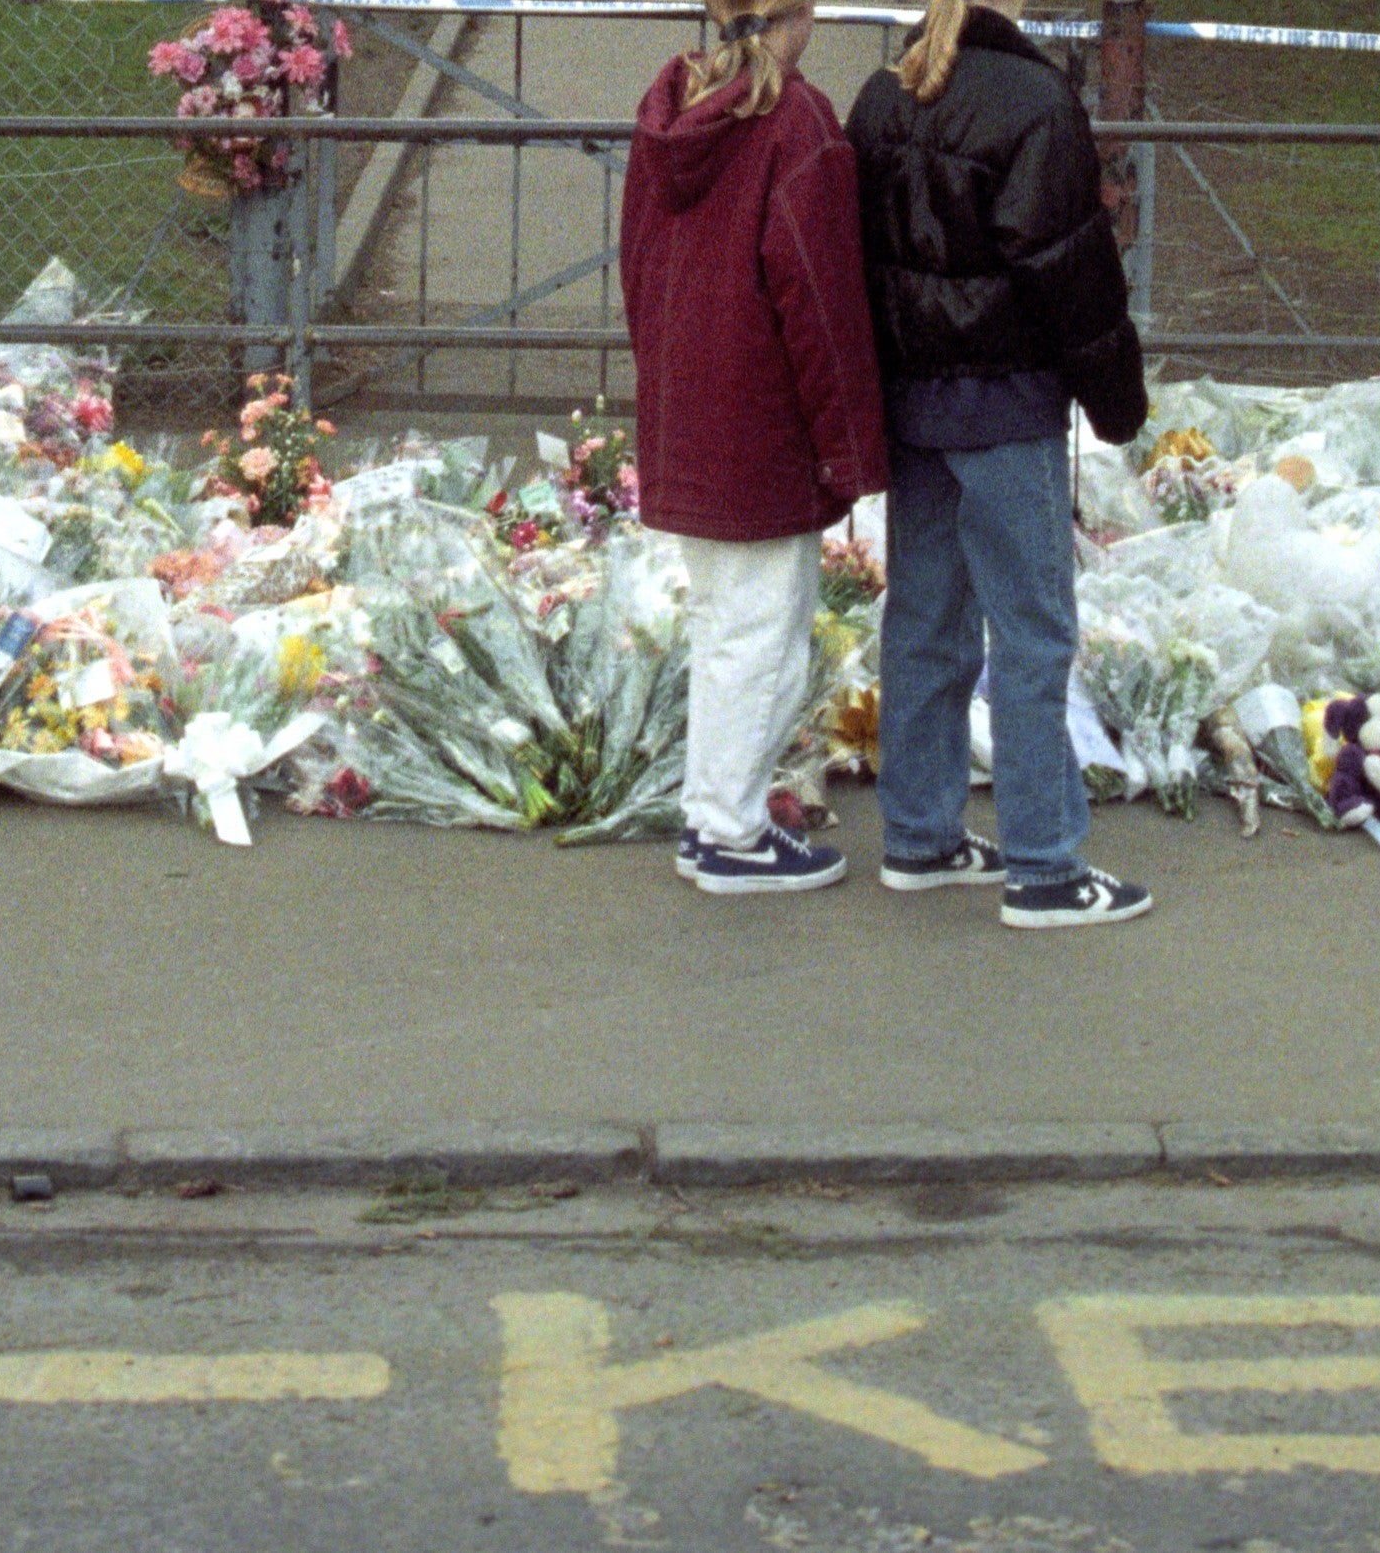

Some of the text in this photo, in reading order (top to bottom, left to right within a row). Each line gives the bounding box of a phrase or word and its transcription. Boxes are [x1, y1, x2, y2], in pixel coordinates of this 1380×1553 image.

[1216, 24, 1273, 44] POLICE
[1277, 28, 1313, 46] LINE
[1318, 31, 1340, 48] DO
[1345, 33, 1379, 50] NOT
